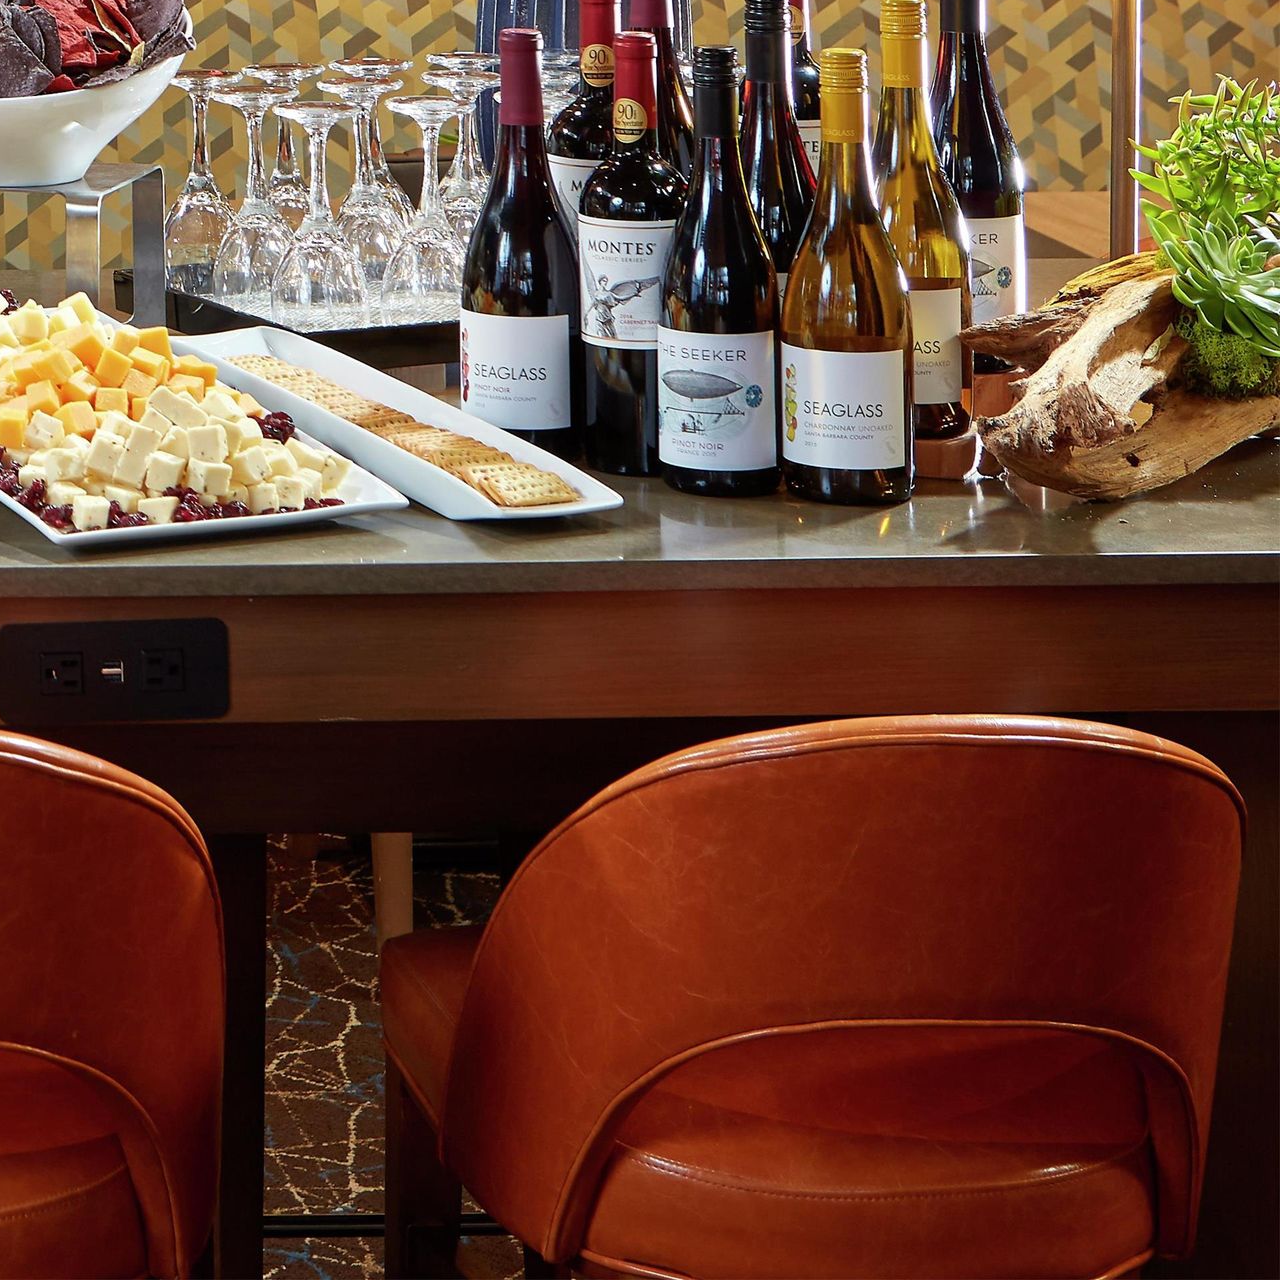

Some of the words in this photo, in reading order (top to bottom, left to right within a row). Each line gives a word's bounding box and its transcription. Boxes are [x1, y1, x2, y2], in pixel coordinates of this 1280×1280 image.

[589, 49, 606, 65] 90
[618, 103, 633, 119] 90
[588, 239, 655, 256] MONTES
[681, 347, 748, 361] SEEKER
[474, 363, 547, 381] SEAGLASS
[803, 400, 883, 418] SEAGLASS
[804, 421, 855, 432] CHARDONNAY
[672, 438, 696, 449] PINOT
[699, 440, 725, 451] NOIR
